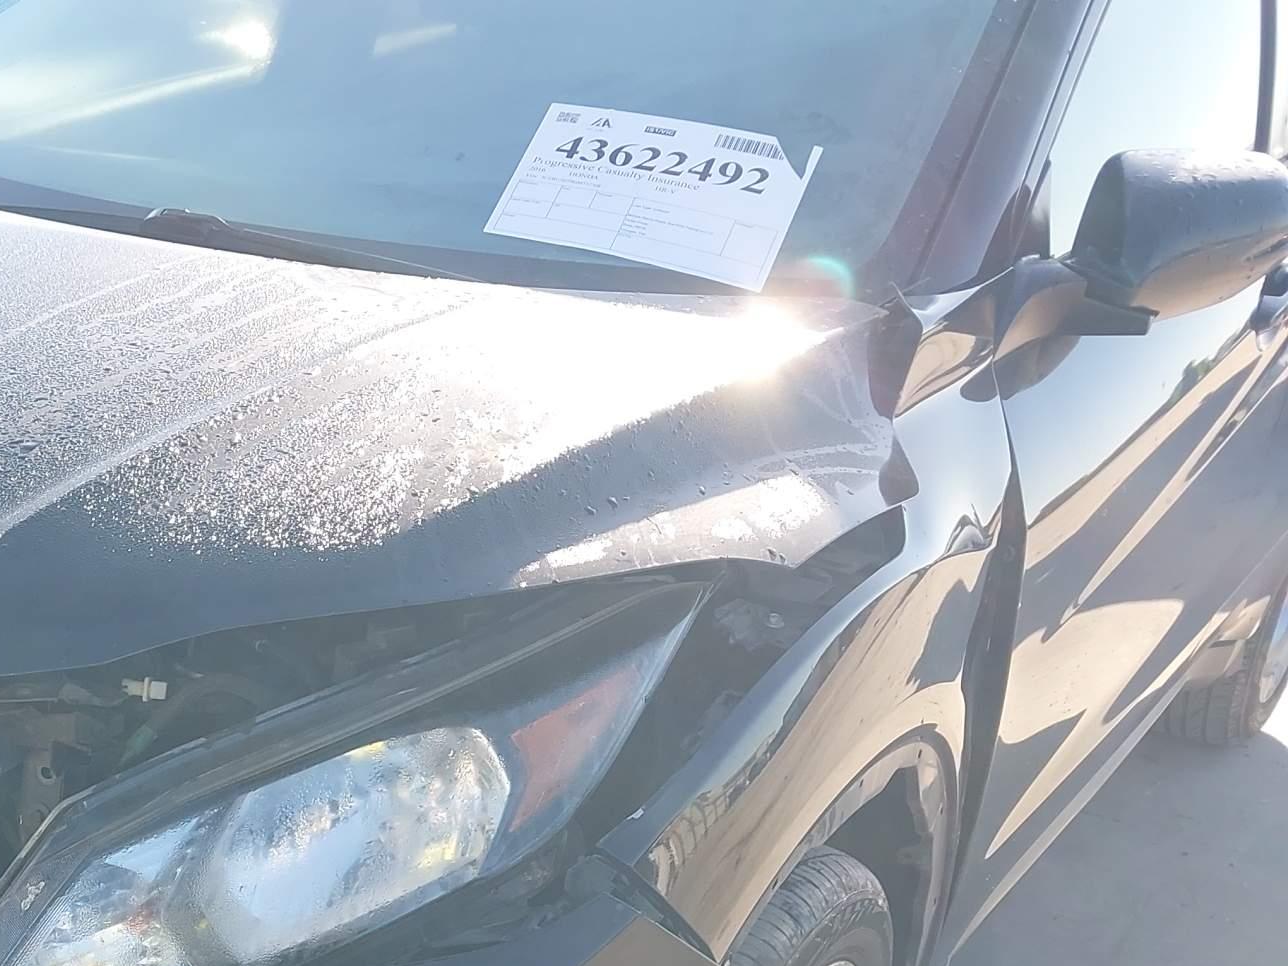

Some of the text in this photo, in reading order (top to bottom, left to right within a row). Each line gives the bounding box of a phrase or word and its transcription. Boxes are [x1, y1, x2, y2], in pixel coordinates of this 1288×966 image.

[532, 156, 596, 172] Progressive
[597, 166, 642, 181] Casualty
[647, 174, 700, 191] Insurance
[555, 136, 770, 195] 43622492
